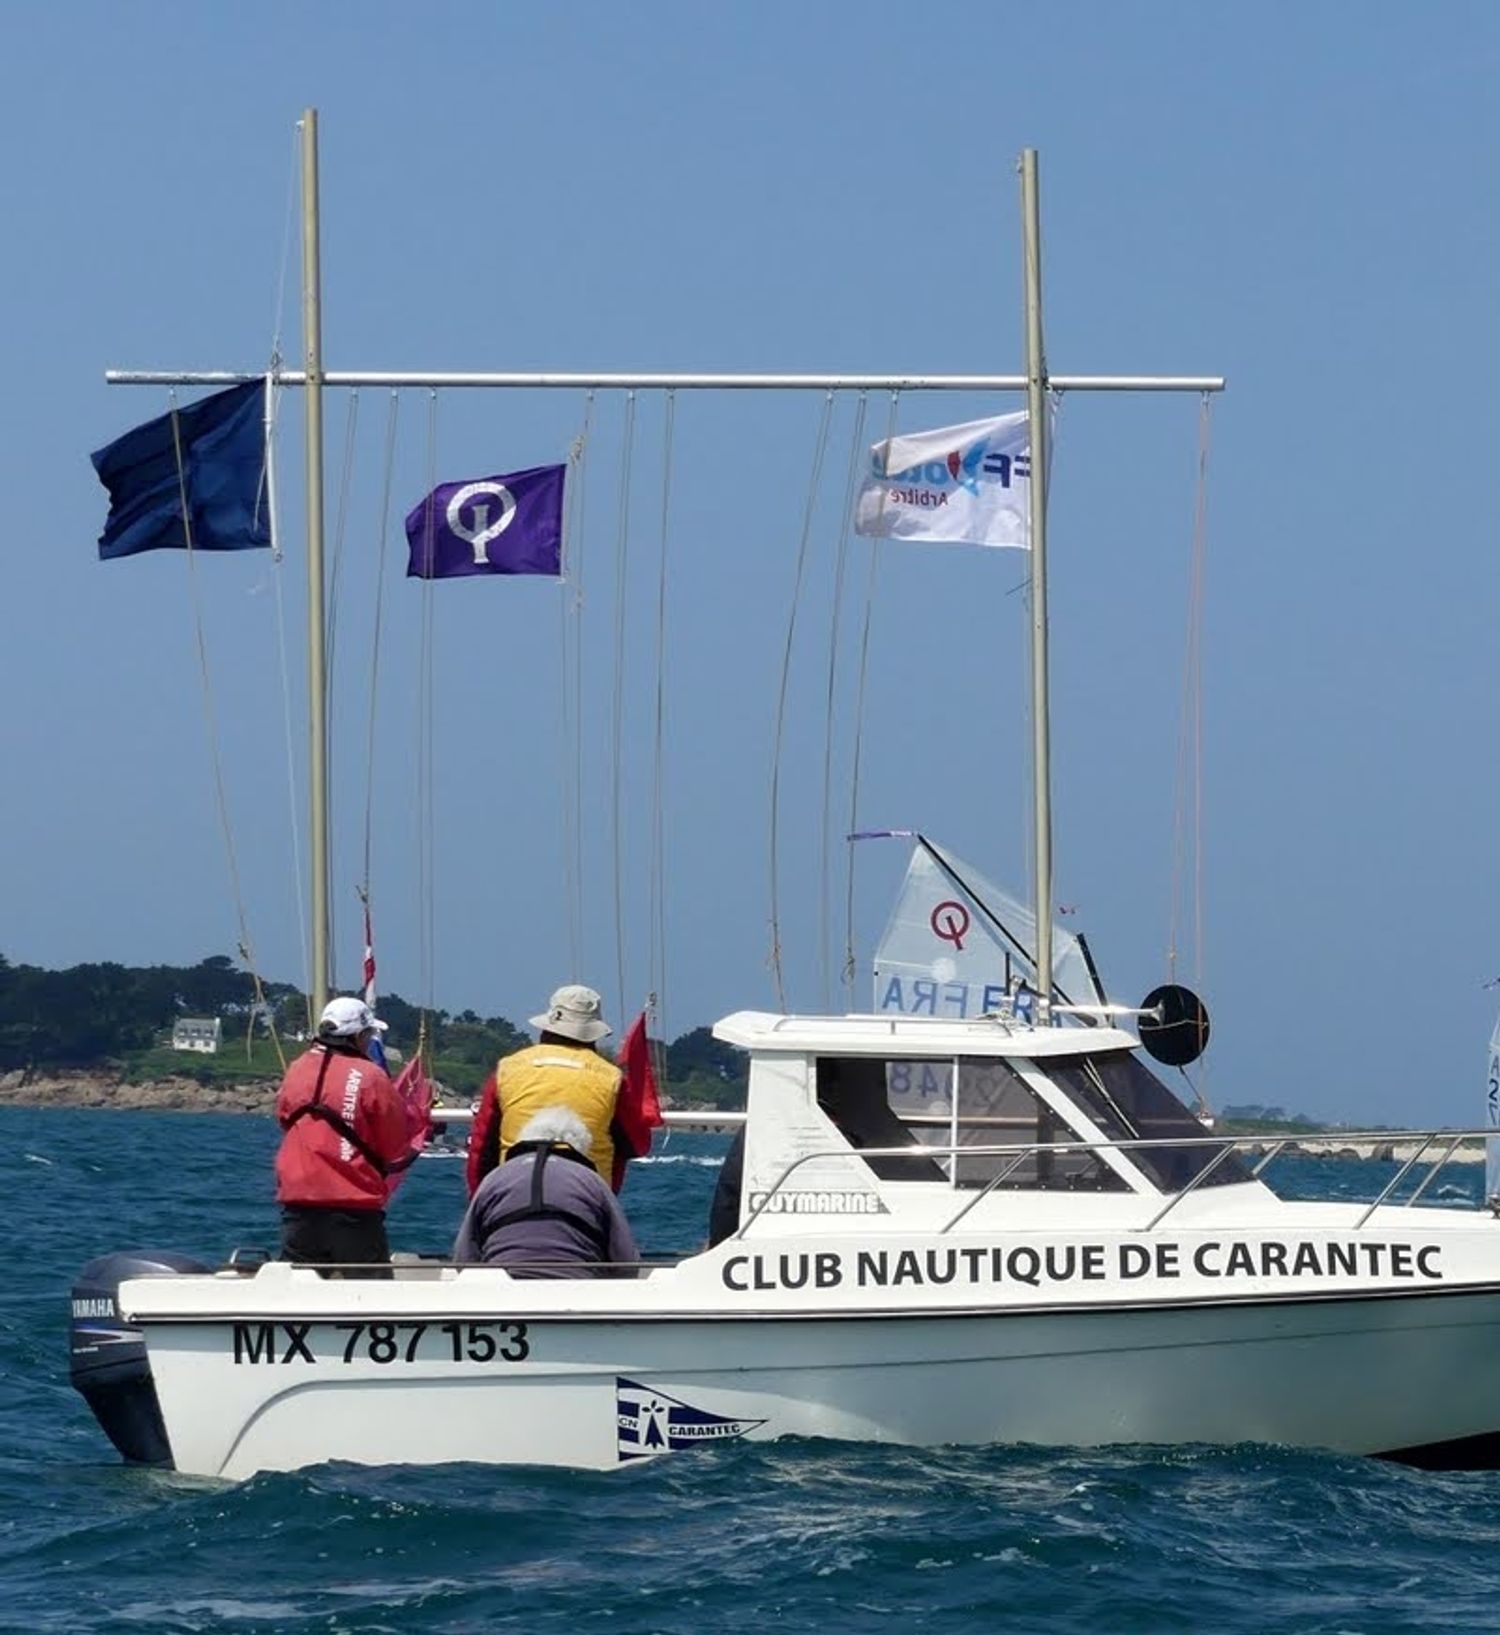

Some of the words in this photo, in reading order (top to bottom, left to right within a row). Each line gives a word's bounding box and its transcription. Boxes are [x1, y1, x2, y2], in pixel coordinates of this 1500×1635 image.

[341, 1068, 363, 1121] ARBITRE
[751, 1192, 879, 1213] GUYMARINE
[721, 1252, 843, 1292] CLUB
[857, 1244, 1106, 1288] NAUTIQUE
[1118, 1242, 1181, 1280] DE
[1193, 1241, 1444, 1279] CARANTEC
[233, 1323, 317, 1364] MX
[334, 1322, 428, 1364] 787
[442, 1323, 530, 1363] 153
[618, 1416, 639, 1429] CN
[668, 1423, 741, 1437] CARANTEC
